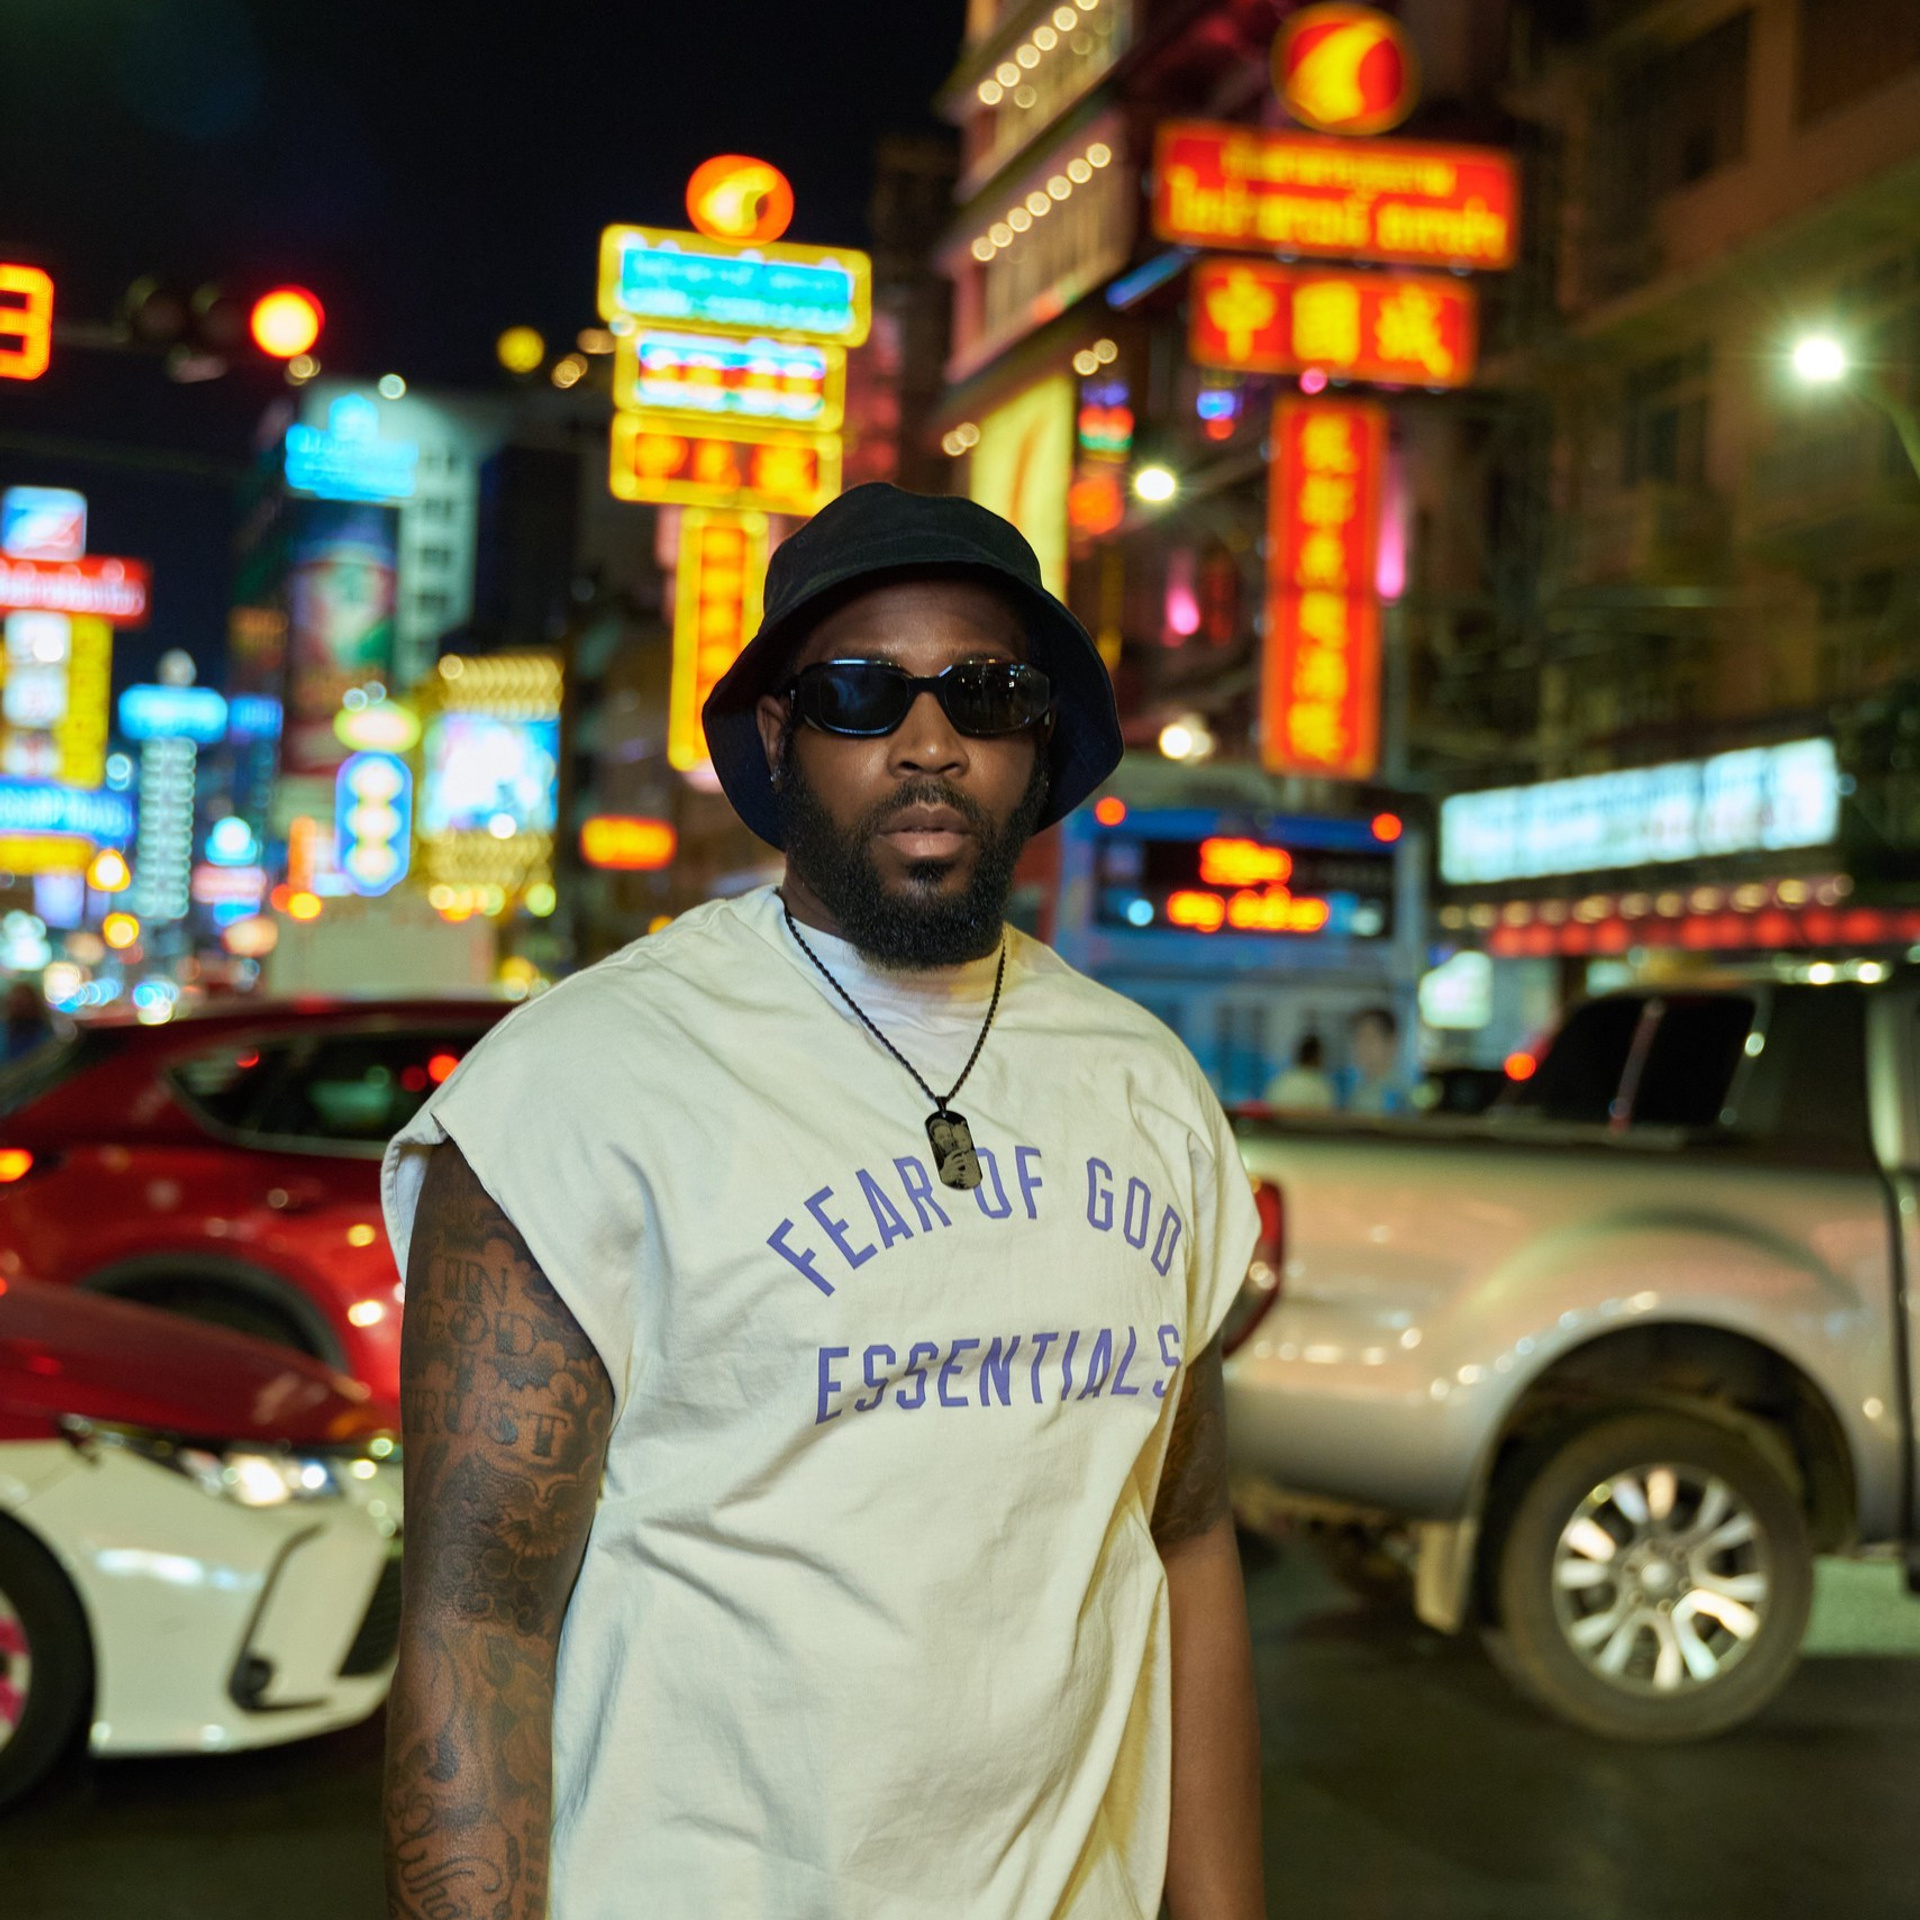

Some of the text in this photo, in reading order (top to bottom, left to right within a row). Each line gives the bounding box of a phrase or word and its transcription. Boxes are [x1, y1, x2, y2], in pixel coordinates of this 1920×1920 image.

[766, 1145, 1182, 1297] FEAR OF GOD
[417, 1300, 536, 1357] GOD
[814, 1323, 1181, 1425] ESSENTIALS
